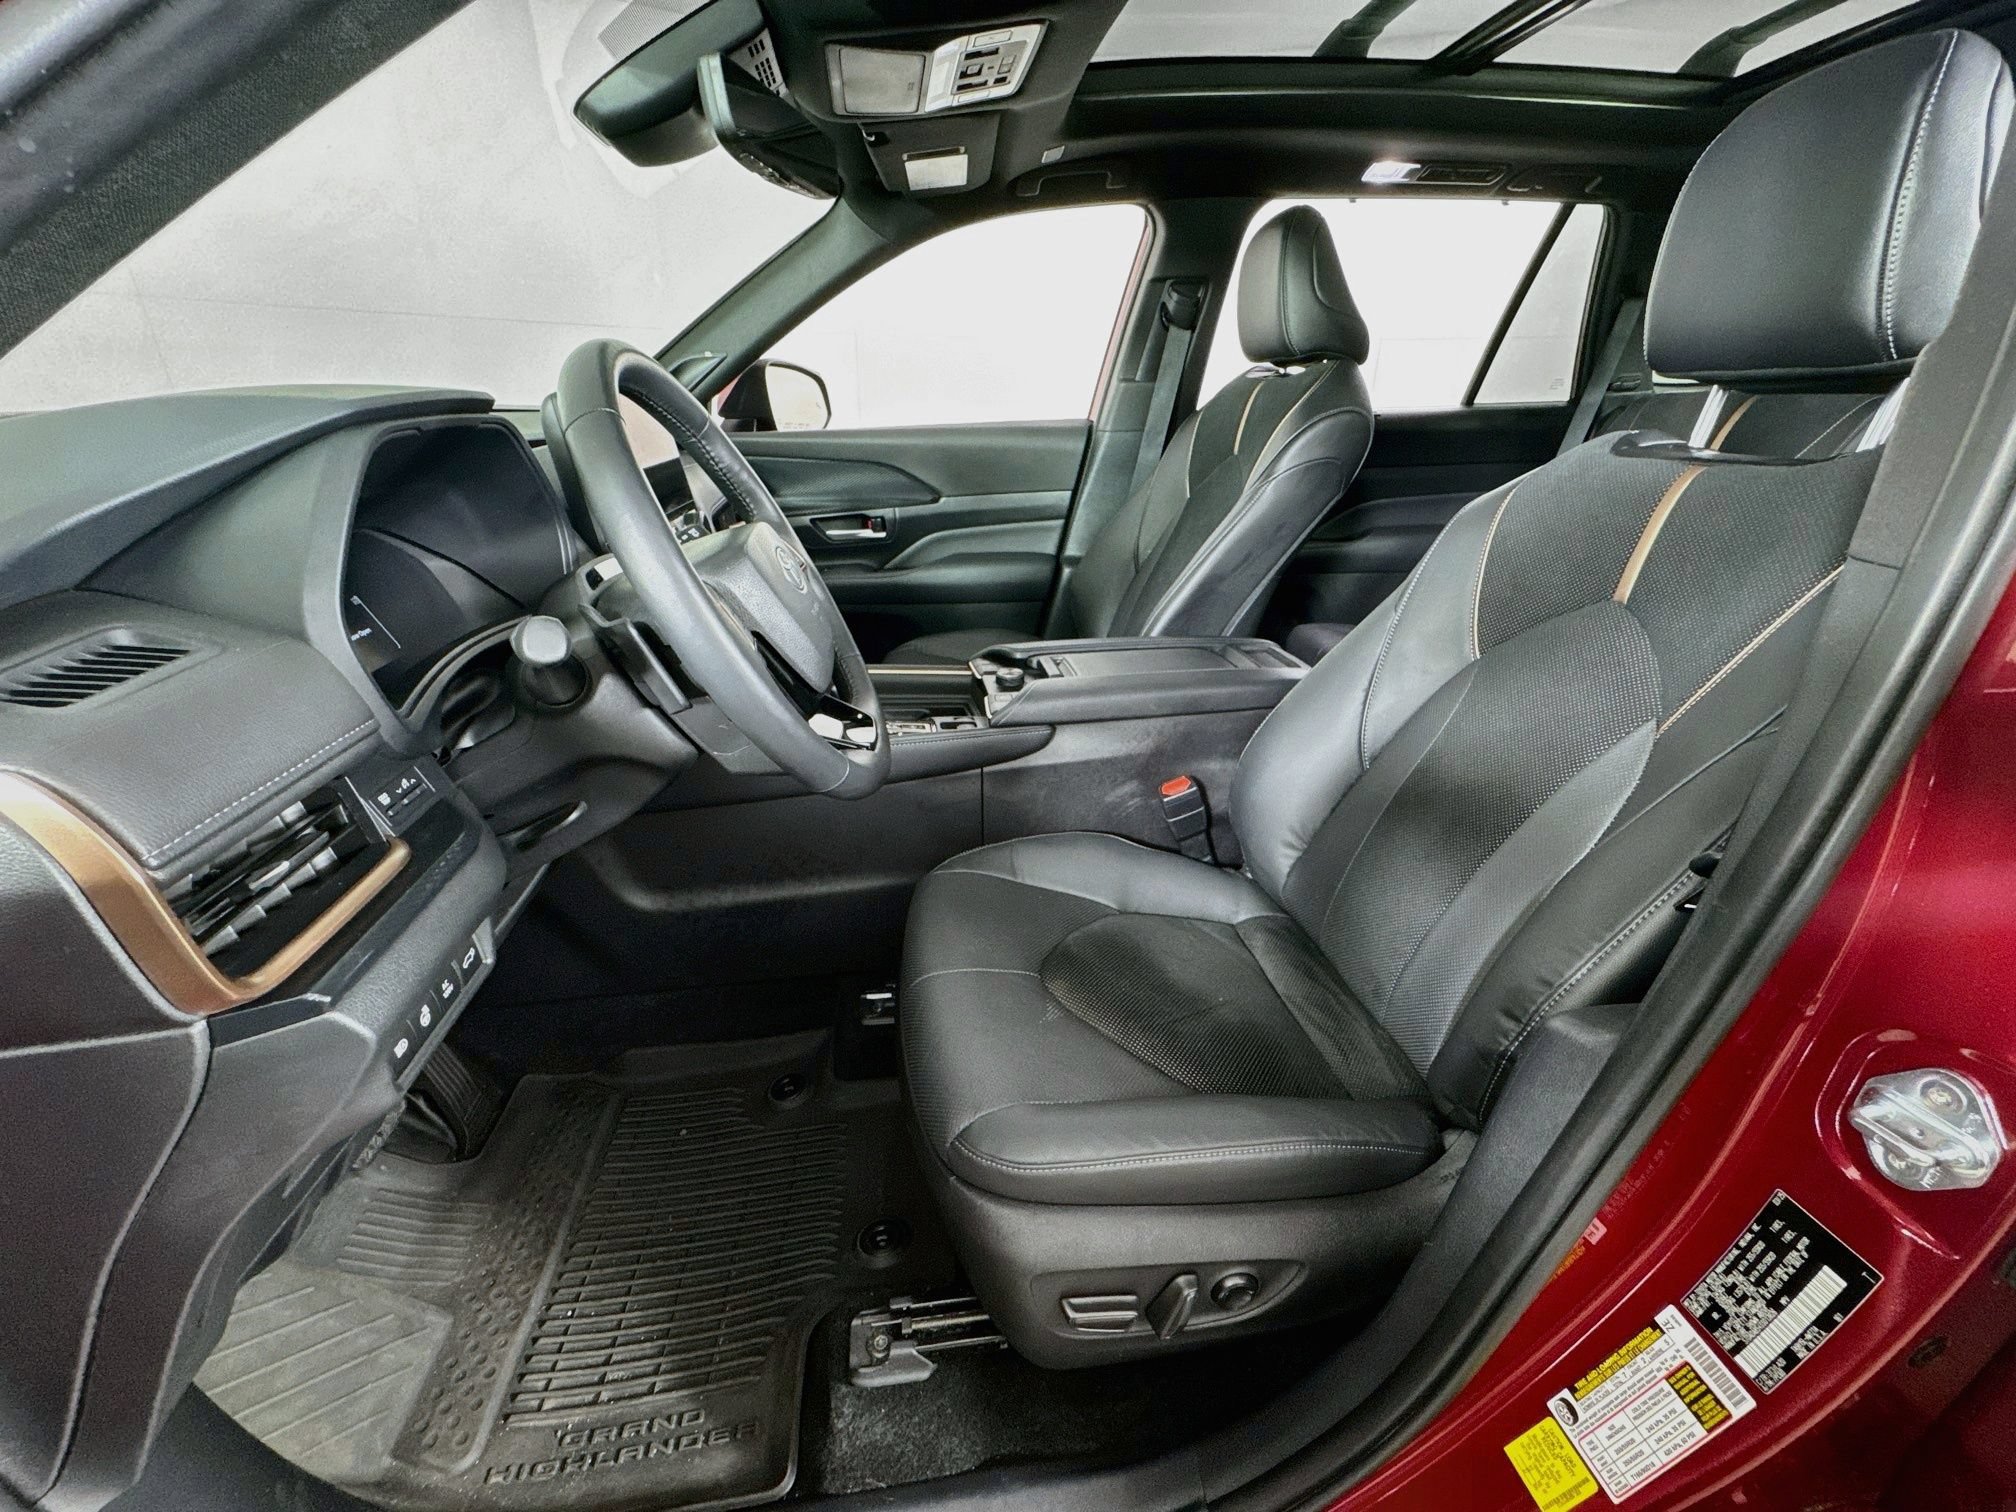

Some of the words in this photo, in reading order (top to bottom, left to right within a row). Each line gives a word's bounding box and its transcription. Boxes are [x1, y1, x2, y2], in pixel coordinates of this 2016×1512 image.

[1585, 1369, 1599, 1382] AND
[558, 1407, 706, 1449] GRAND
[483, 1423, 757, 1486] HIGHLANDER
